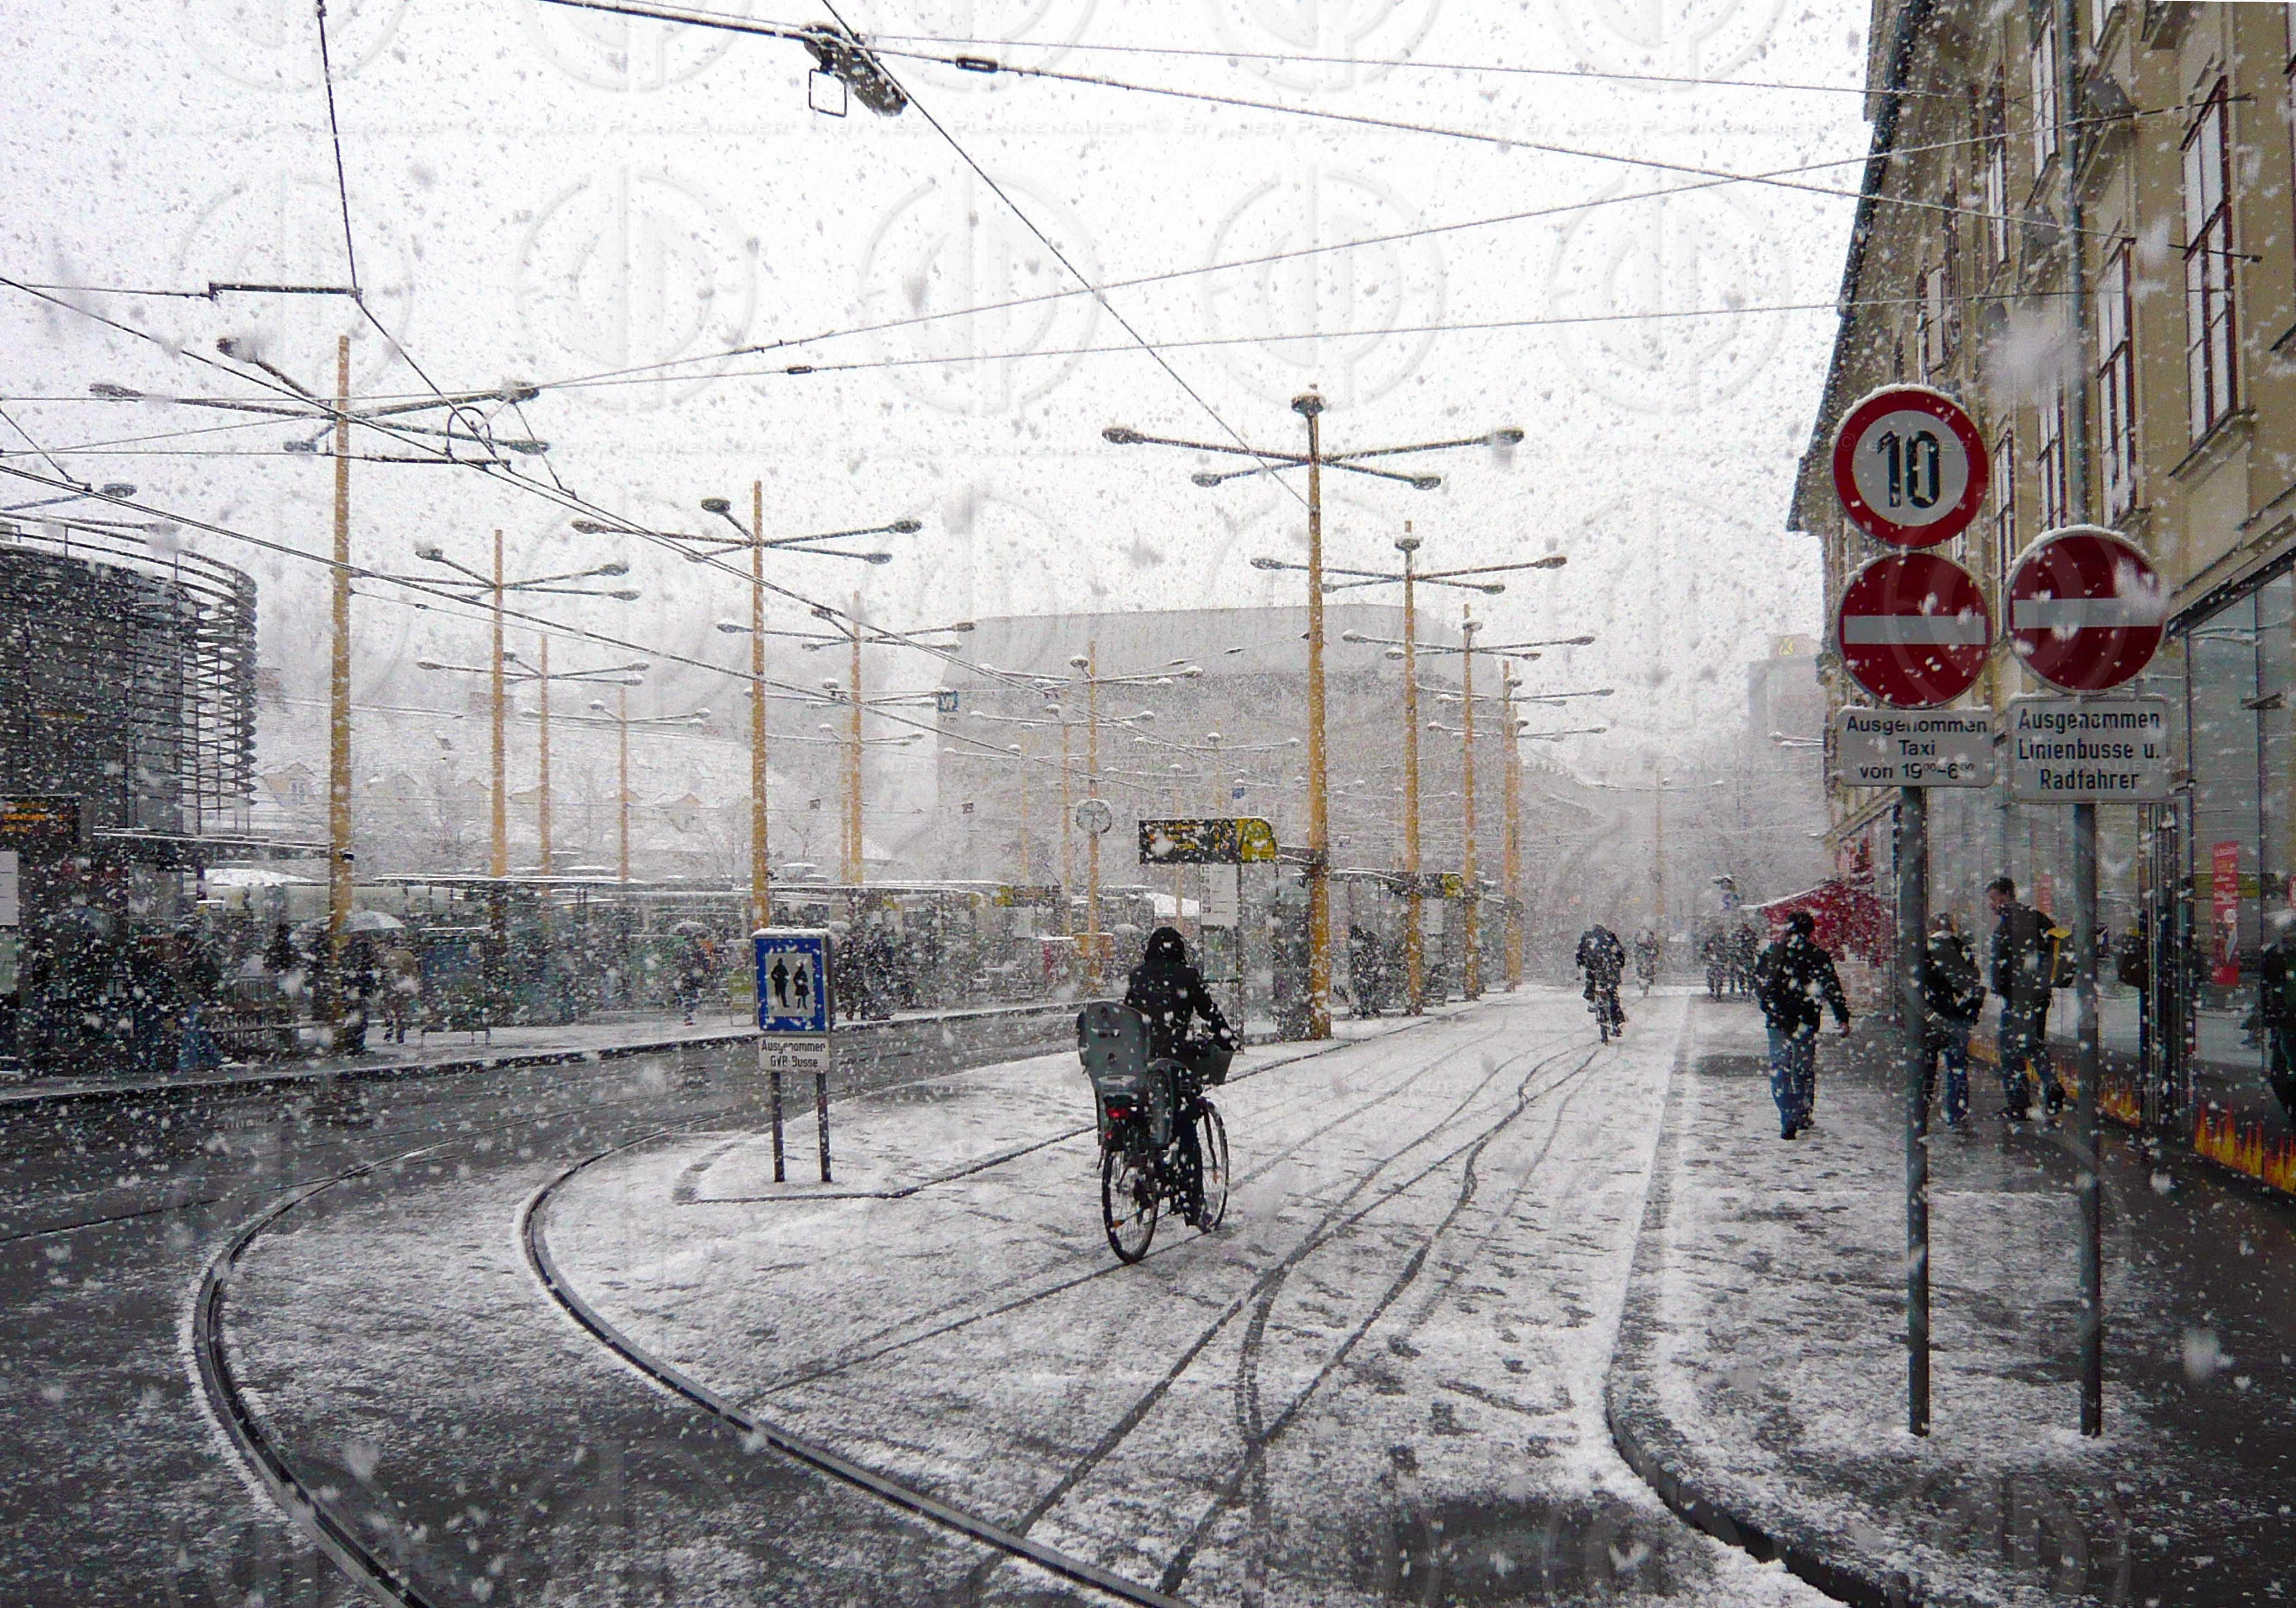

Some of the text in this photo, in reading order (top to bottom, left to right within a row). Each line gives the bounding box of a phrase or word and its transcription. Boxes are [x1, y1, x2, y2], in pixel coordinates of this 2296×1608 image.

[1877, 430, 1940, 509] 10
[1847, 716, 1986, 735] Ausgenommen
[2018, 708, 2159, 734] Ausgenommen
[1898, 739, 1935, 756] Taxi
[2018, 738, 2159, 759] Linienbusse u.
[1860, 766, 1893, 779] von
[2040, 768, 2139, 790] Radfahrer
